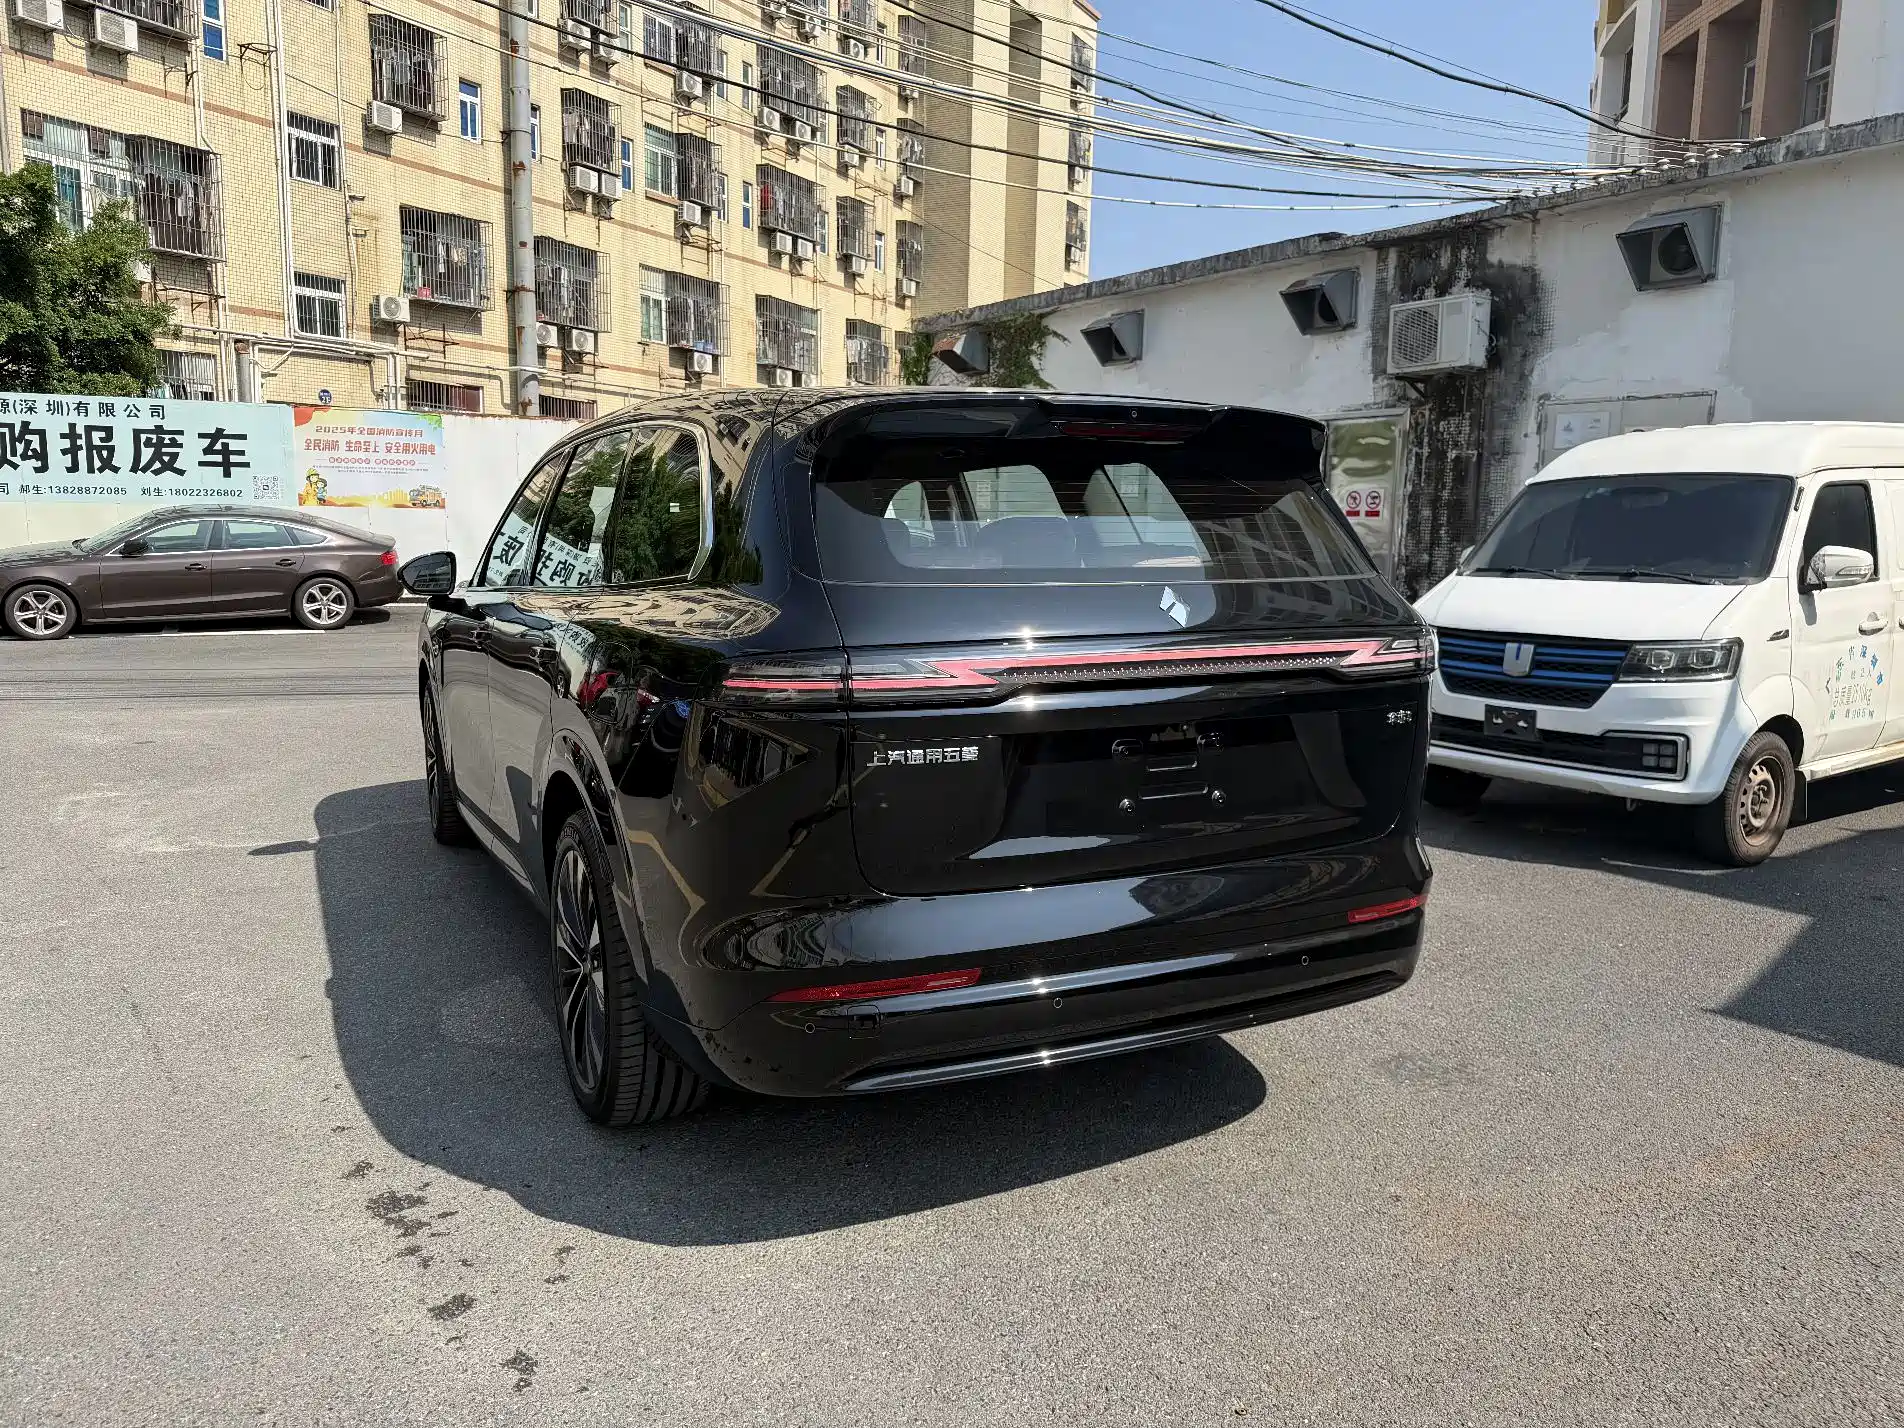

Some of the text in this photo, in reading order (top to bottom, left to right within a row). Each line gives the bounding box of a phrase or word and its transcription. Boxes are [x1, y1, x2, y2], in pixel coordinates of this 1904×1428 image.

[0, 420, 251, 478] 购报废车
[304, 438, 436, 456] 全民消防 生命至上 安全用火用电
[867, 746, 979, 767] 上汽通用五菱
